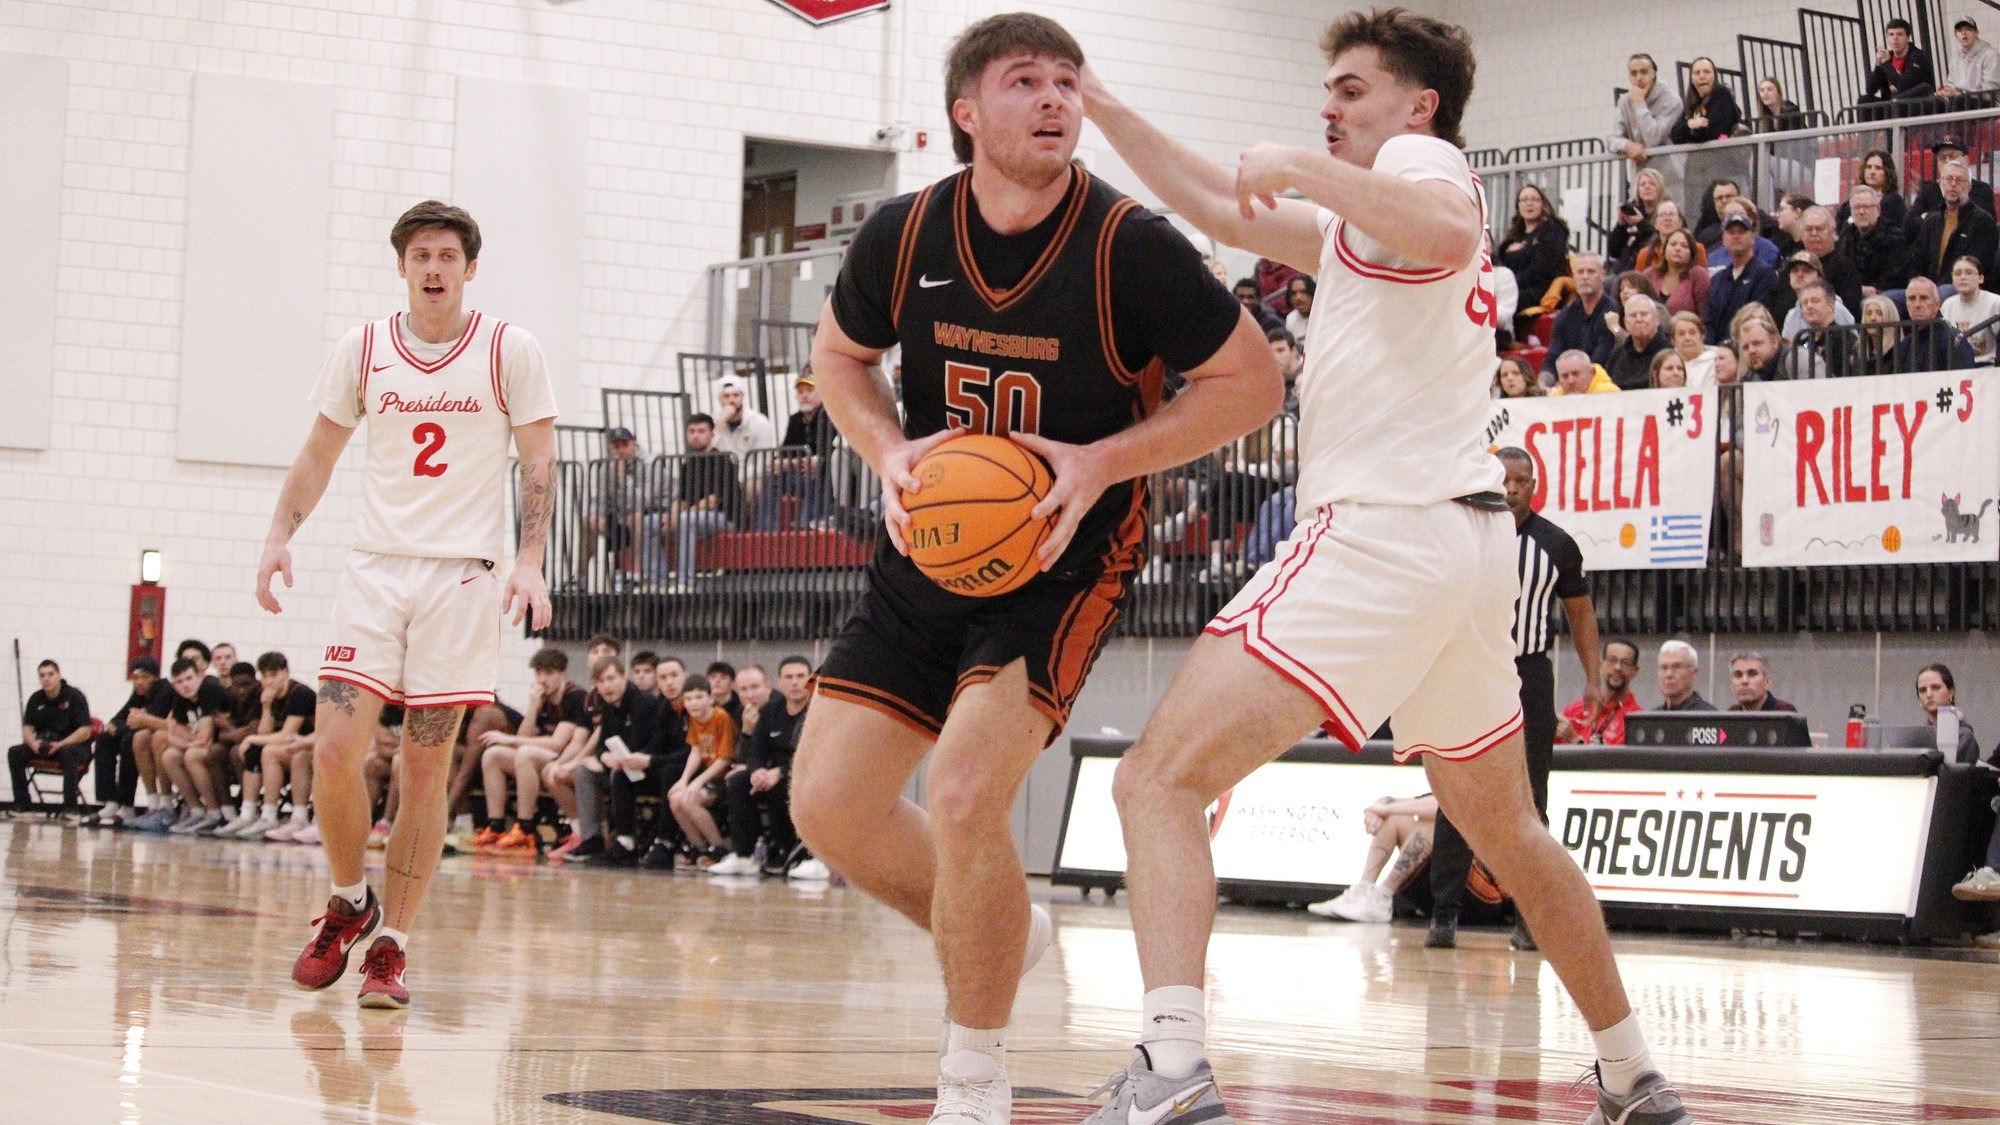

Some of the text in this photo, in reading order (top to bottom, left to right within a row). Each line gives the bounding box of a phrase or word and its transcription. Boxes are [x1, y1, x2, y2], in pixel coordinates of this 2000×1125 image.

[934, 321, 1059, 360] WAYNESBURG
[378, 391, 482, 414] Presidents
[945, 361, 1041, 437] 50
[1666, 394, 1703, 439] #3
[1936, 379, 1973, 423] #5
[412, 422, 448, 477] 2
[1524, 415, 1660, 513] STELLA
[1796, 400, 1928, 508] RILEY
[1693, 727, 1717, 744] POSS
[1562, 807, 1812, 882] PRESIDENTS
